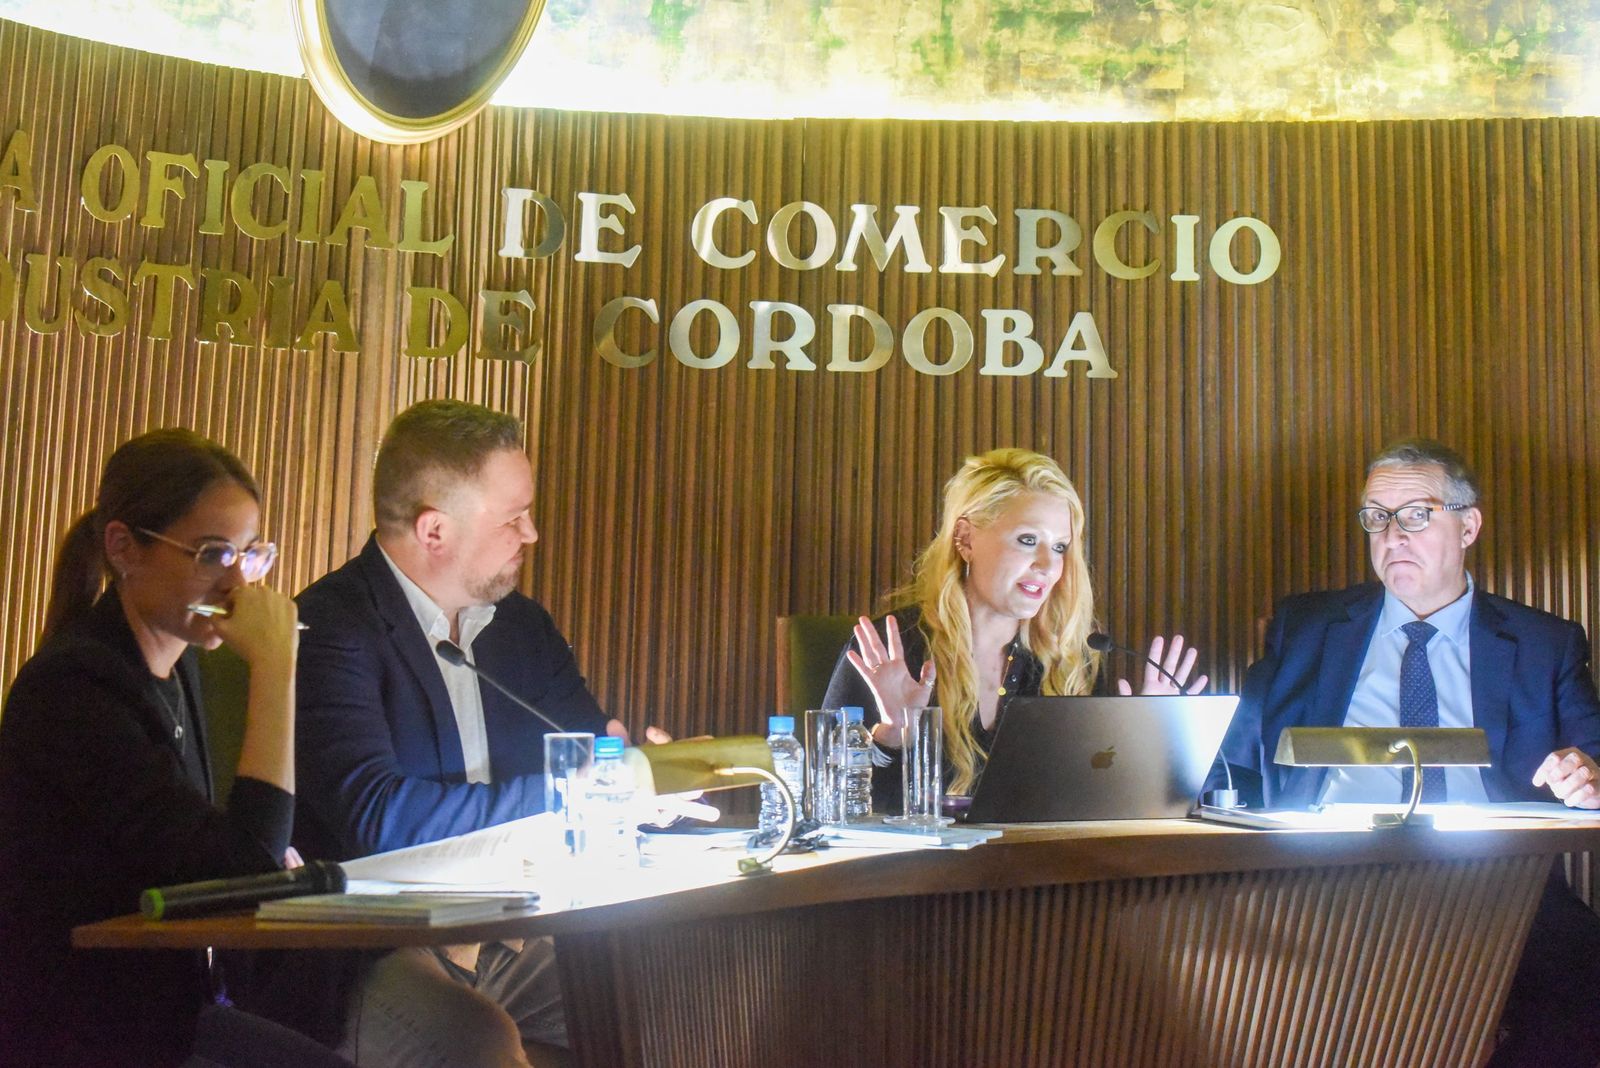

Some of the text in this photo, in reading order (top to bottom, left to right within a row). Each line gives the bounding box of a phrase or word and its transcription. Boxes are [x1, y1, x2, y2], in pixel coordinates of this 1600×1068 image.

[81, 144, 455, 257] OFICIAL
[499, 187, 641, 268] DE
[690, 197, 1282, 285] COMERCIO
[0, 253, 1119, 379] USTRIA DE CORDOBA
